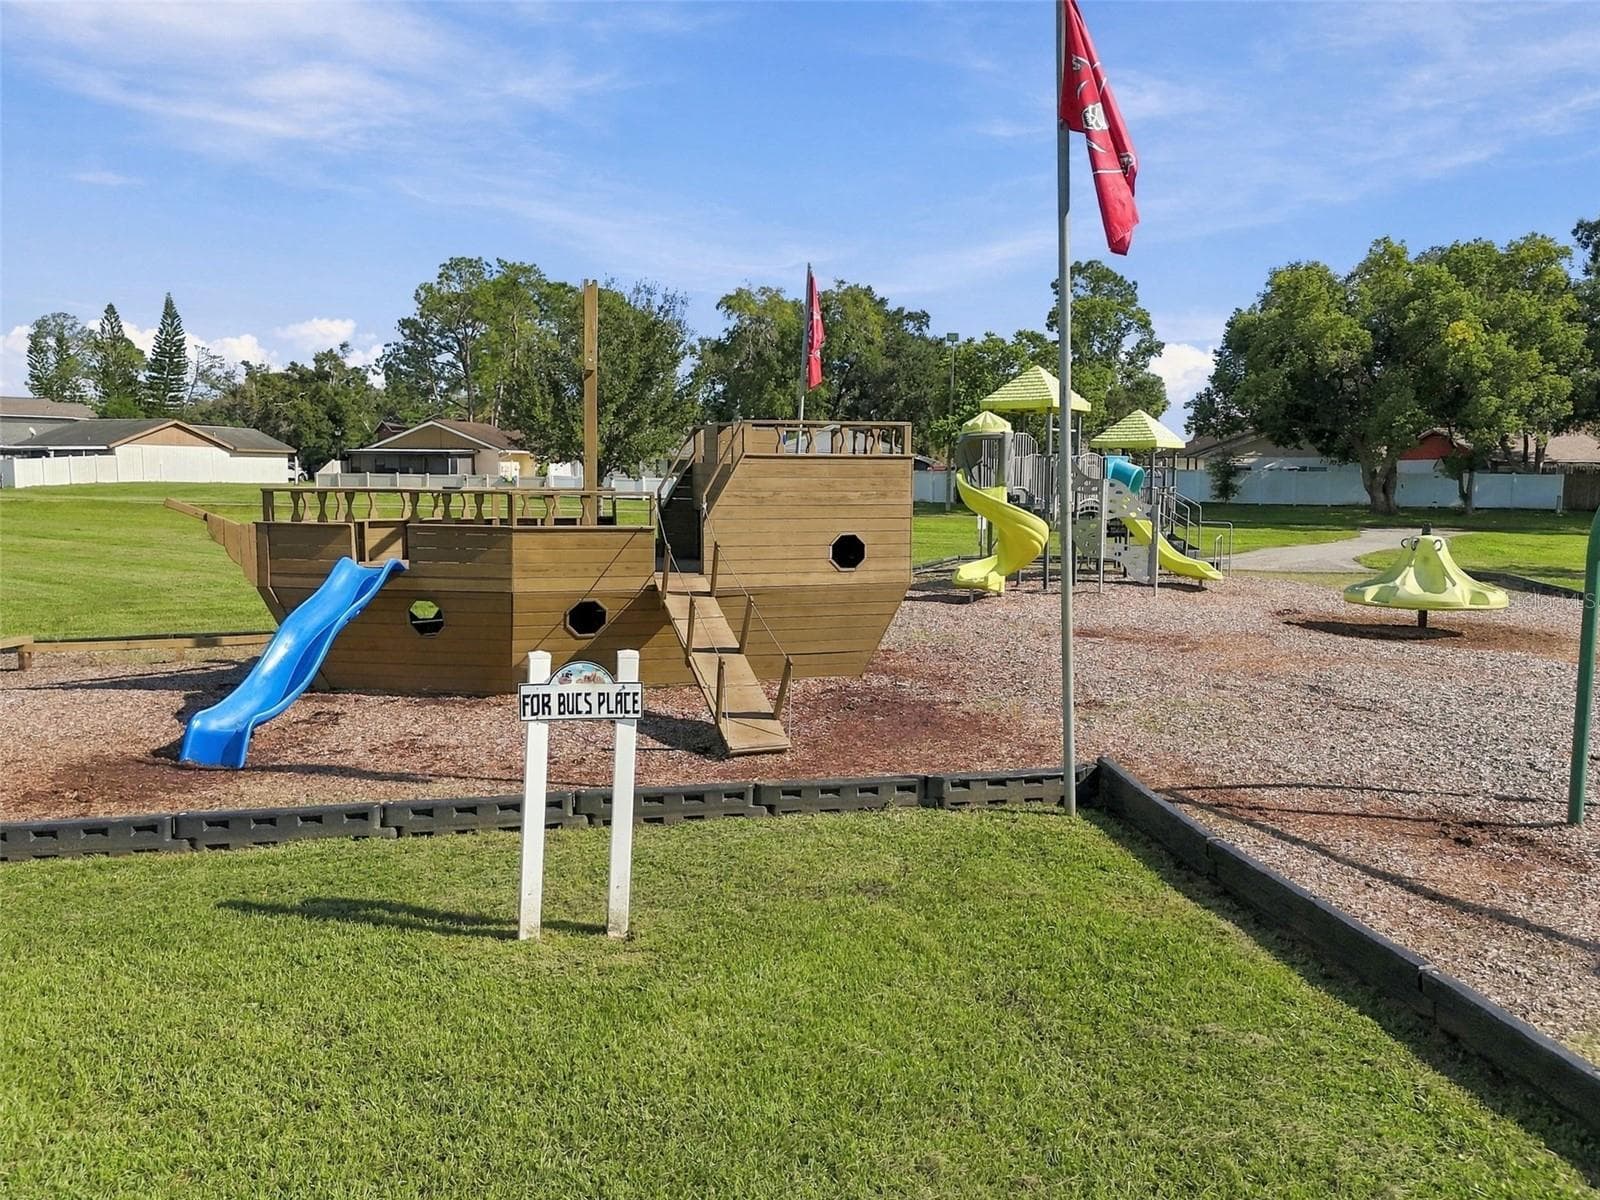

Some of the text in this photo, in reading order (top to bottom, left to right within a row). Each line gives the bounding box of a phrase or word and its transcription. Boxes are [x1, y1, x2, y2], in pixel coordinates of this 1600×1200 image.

[522, 691, 640, 717] FOR BUCS PLACE
